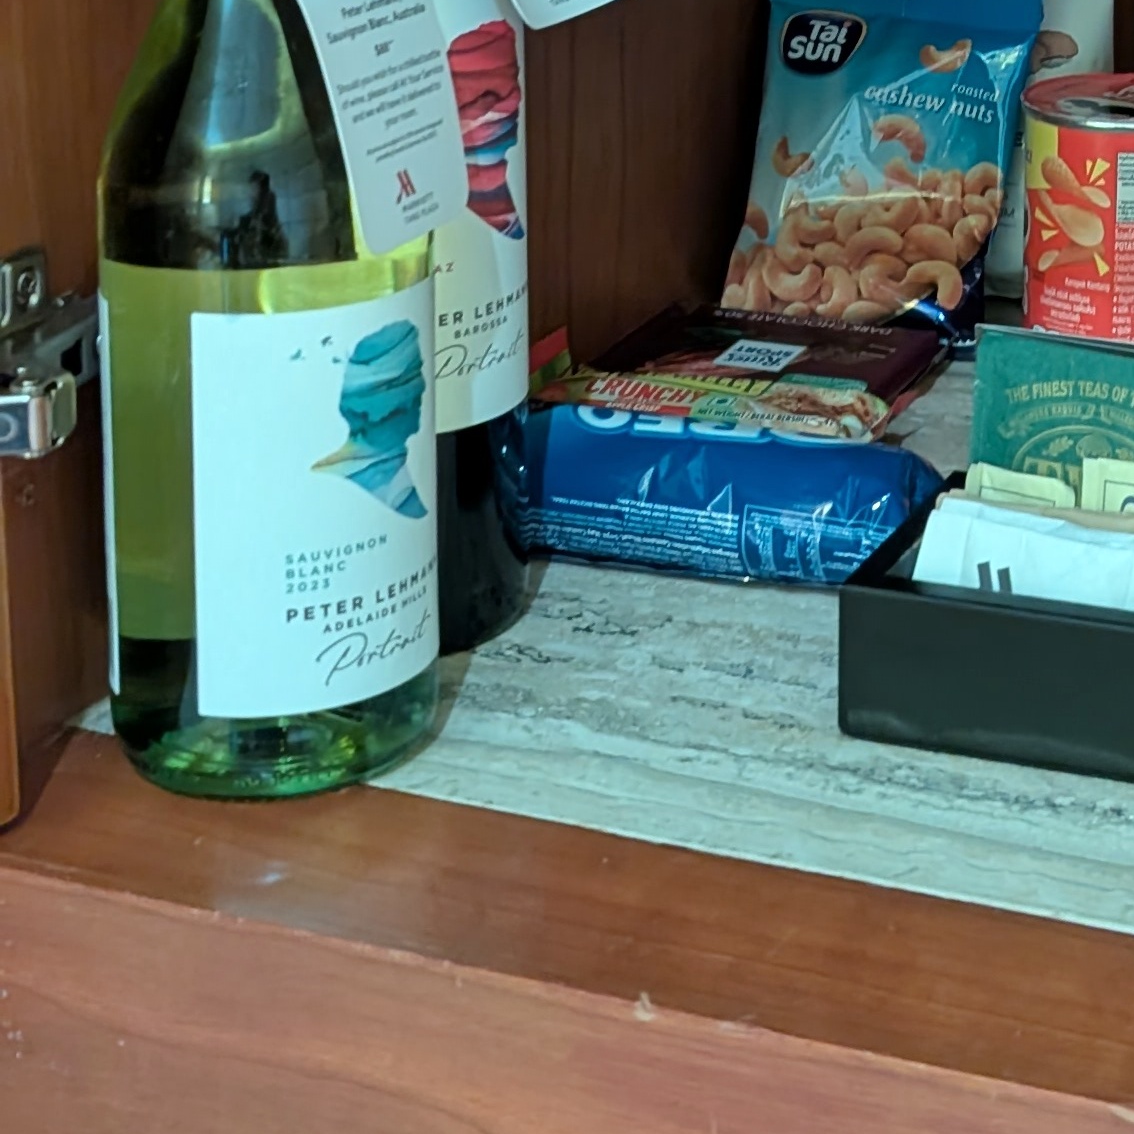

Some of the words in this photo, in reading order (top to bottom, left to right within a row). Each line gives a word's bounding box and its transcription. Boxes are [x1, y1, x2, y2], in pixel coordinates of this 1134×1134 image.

[809, 19, 852, 45] Tai
[864, 83, 946, 113] cashew
[950, 98, 995, 124] nuts
[951, 82, 999, 103] roasted
[454, 315, 508, 339] BAROSSA
[735, 344, 792, 357] SPORT
[585, 375, 709, 404] CRUNCHY
[1005, 384, 1030, 404] THE
[1032, 380, 1075, 400] FINEST
[1077, 380, 1109, 399] TEAS
[1112, 386, 1129, 402] OF
[285, 534, 388, 566] SAUVIGNON
[285, 560, 347, 580] BLANC
[285, 578, 331, 595] 2023
[286, 596, 365, 624] PETER
[323, 604, 397, 635] ADELAIDE
[401, 585, 427, 609] HILLS
